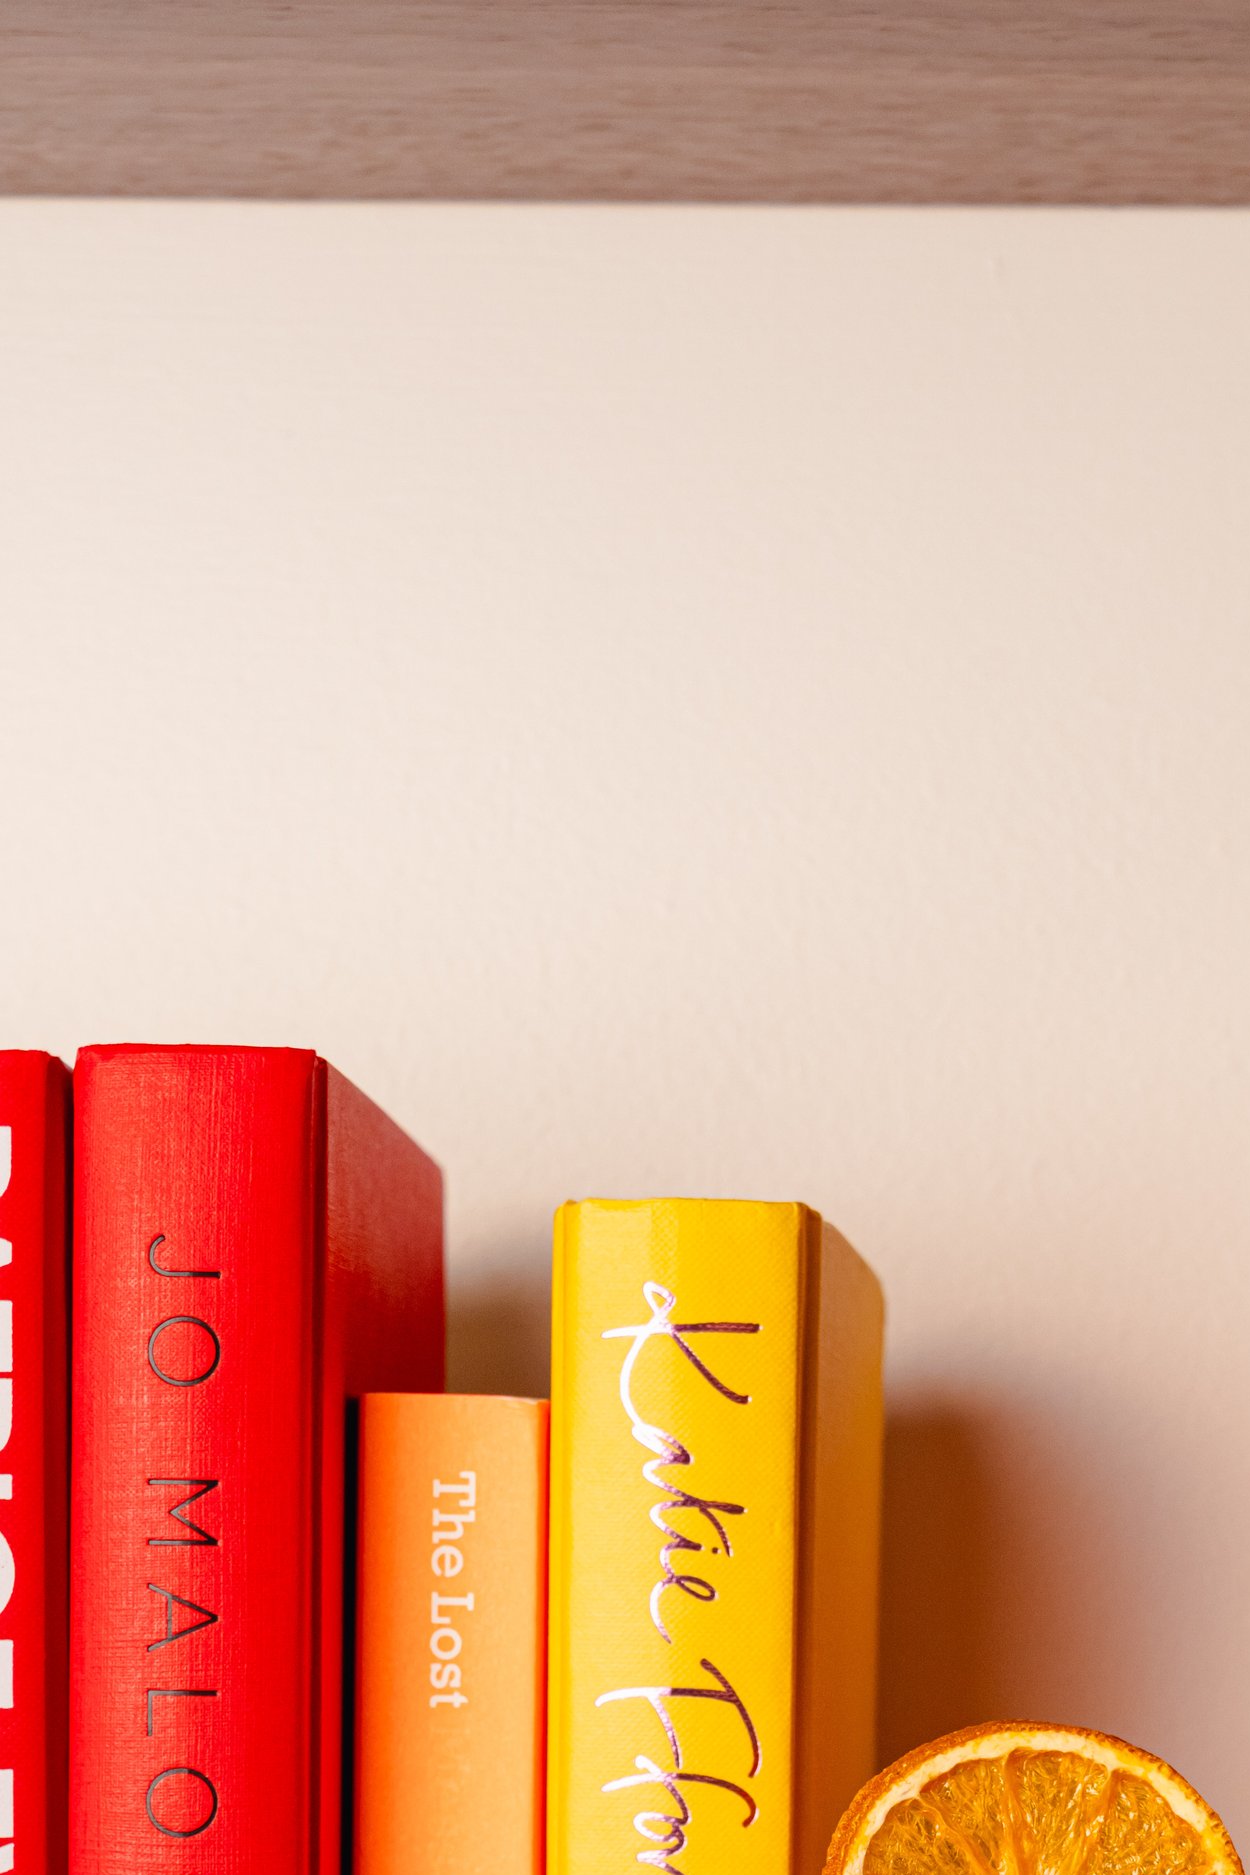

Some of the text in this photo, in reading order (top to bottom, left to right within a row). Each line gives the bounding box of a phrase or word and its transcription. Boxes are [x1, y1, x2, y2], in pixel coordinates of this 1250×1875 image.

[148, 1234, 220, 1386] JO
[434, 1471, 476, 1580] The
[602, 1281, 763, 1644] Katie
[430, 1591, 473, 1708] Lost
